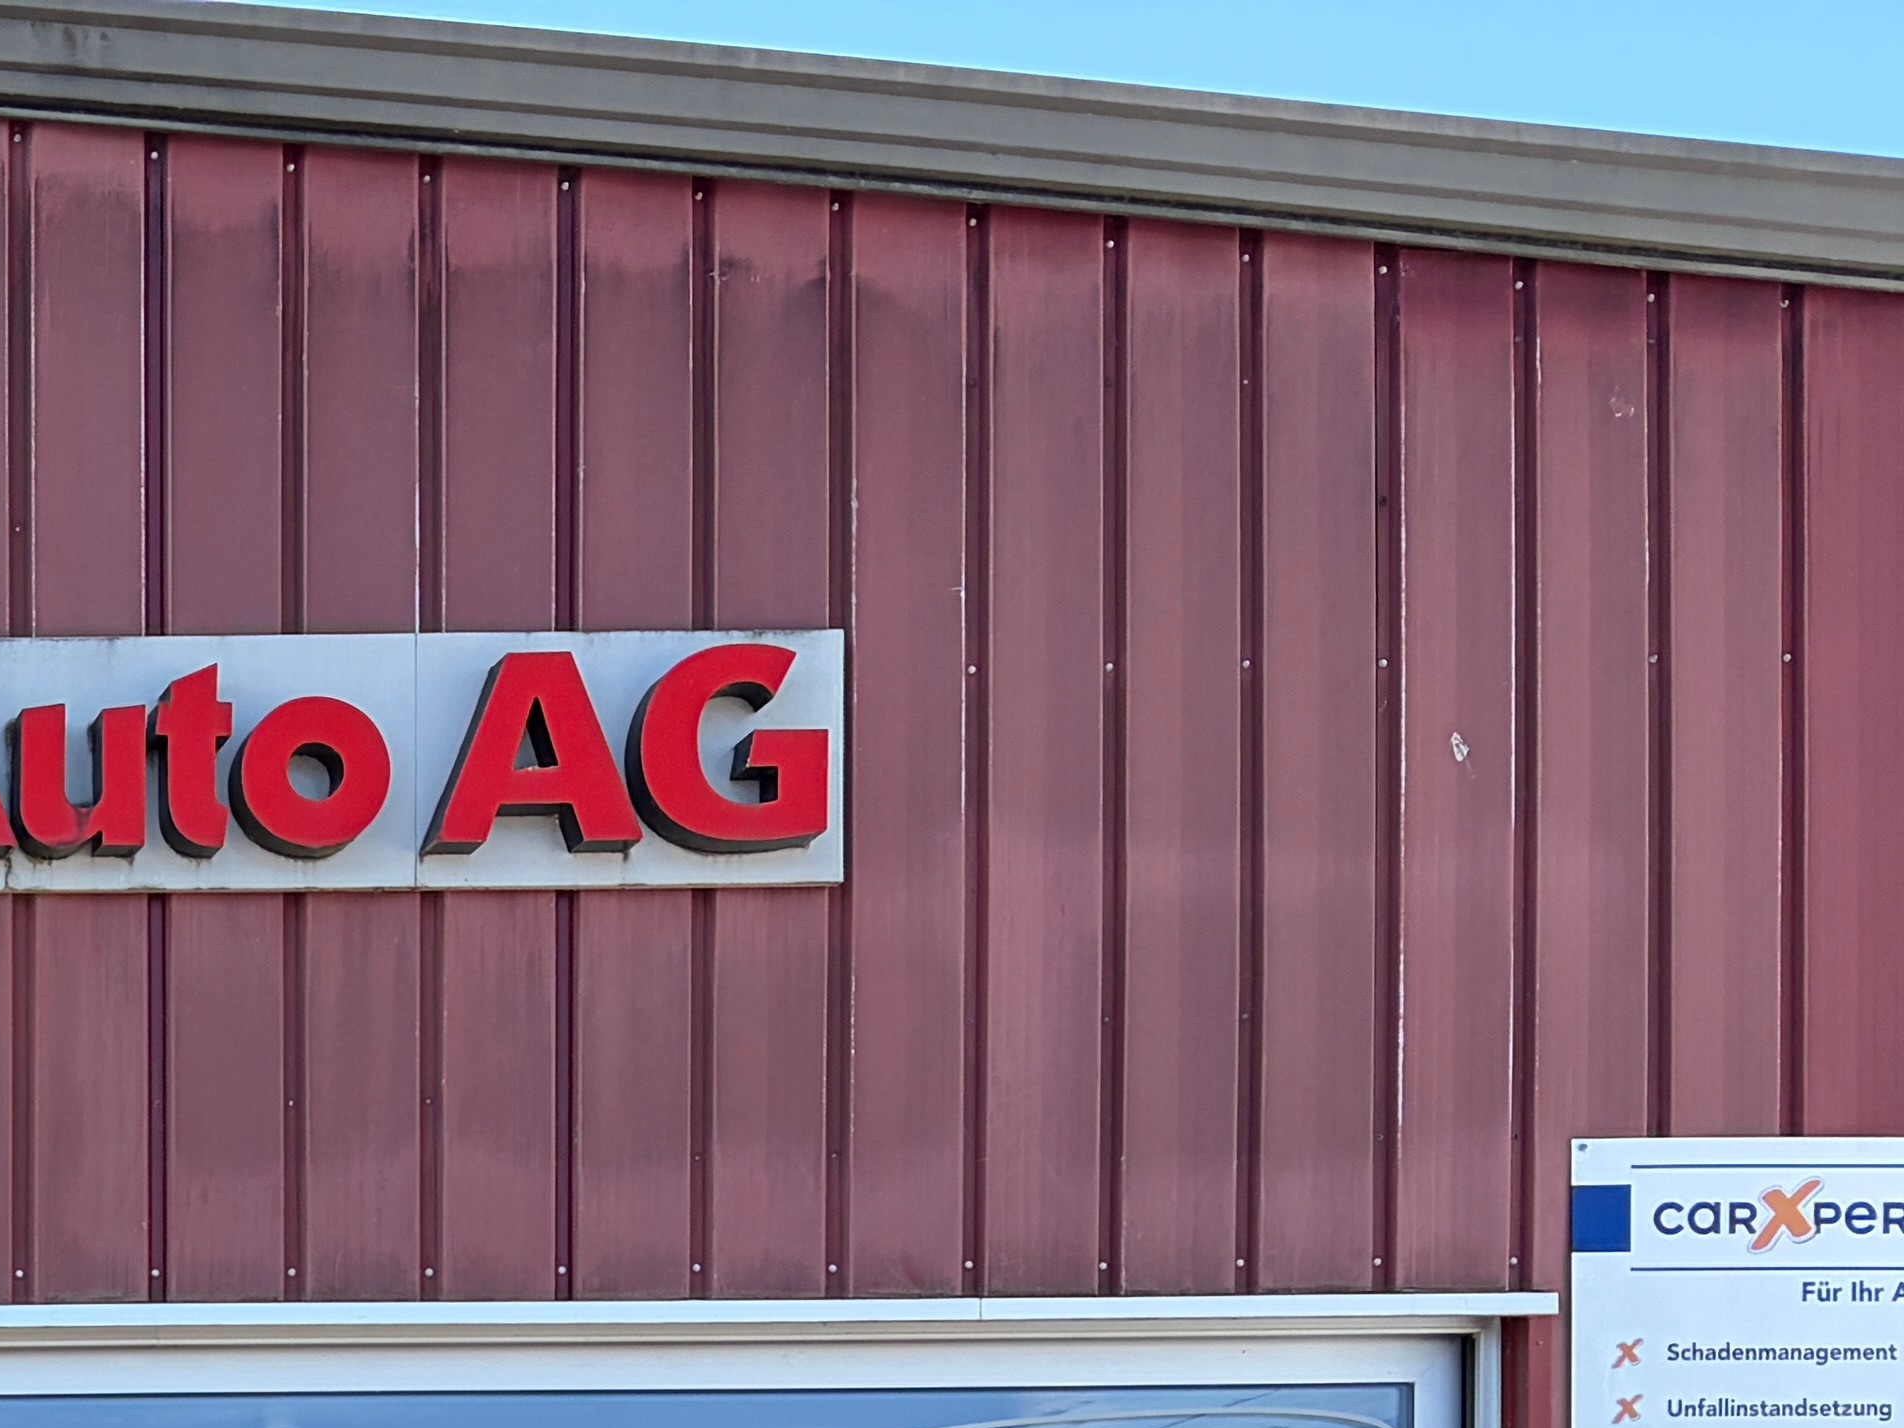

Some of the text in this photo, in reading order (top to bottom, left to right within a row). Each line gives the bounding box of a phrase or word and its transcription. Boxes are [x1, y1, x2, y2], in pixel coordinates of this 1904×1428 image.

[421, 645, 830, 855] AG
[1801, 1280, 1842, 1302] Für
[1852, 1280, 1884, 1302] Ihr
[1667, 1342, 1898, 1366] Schadenmanagement
[1667, 1397, 1893, 1421] Unfallinstandsetzung
